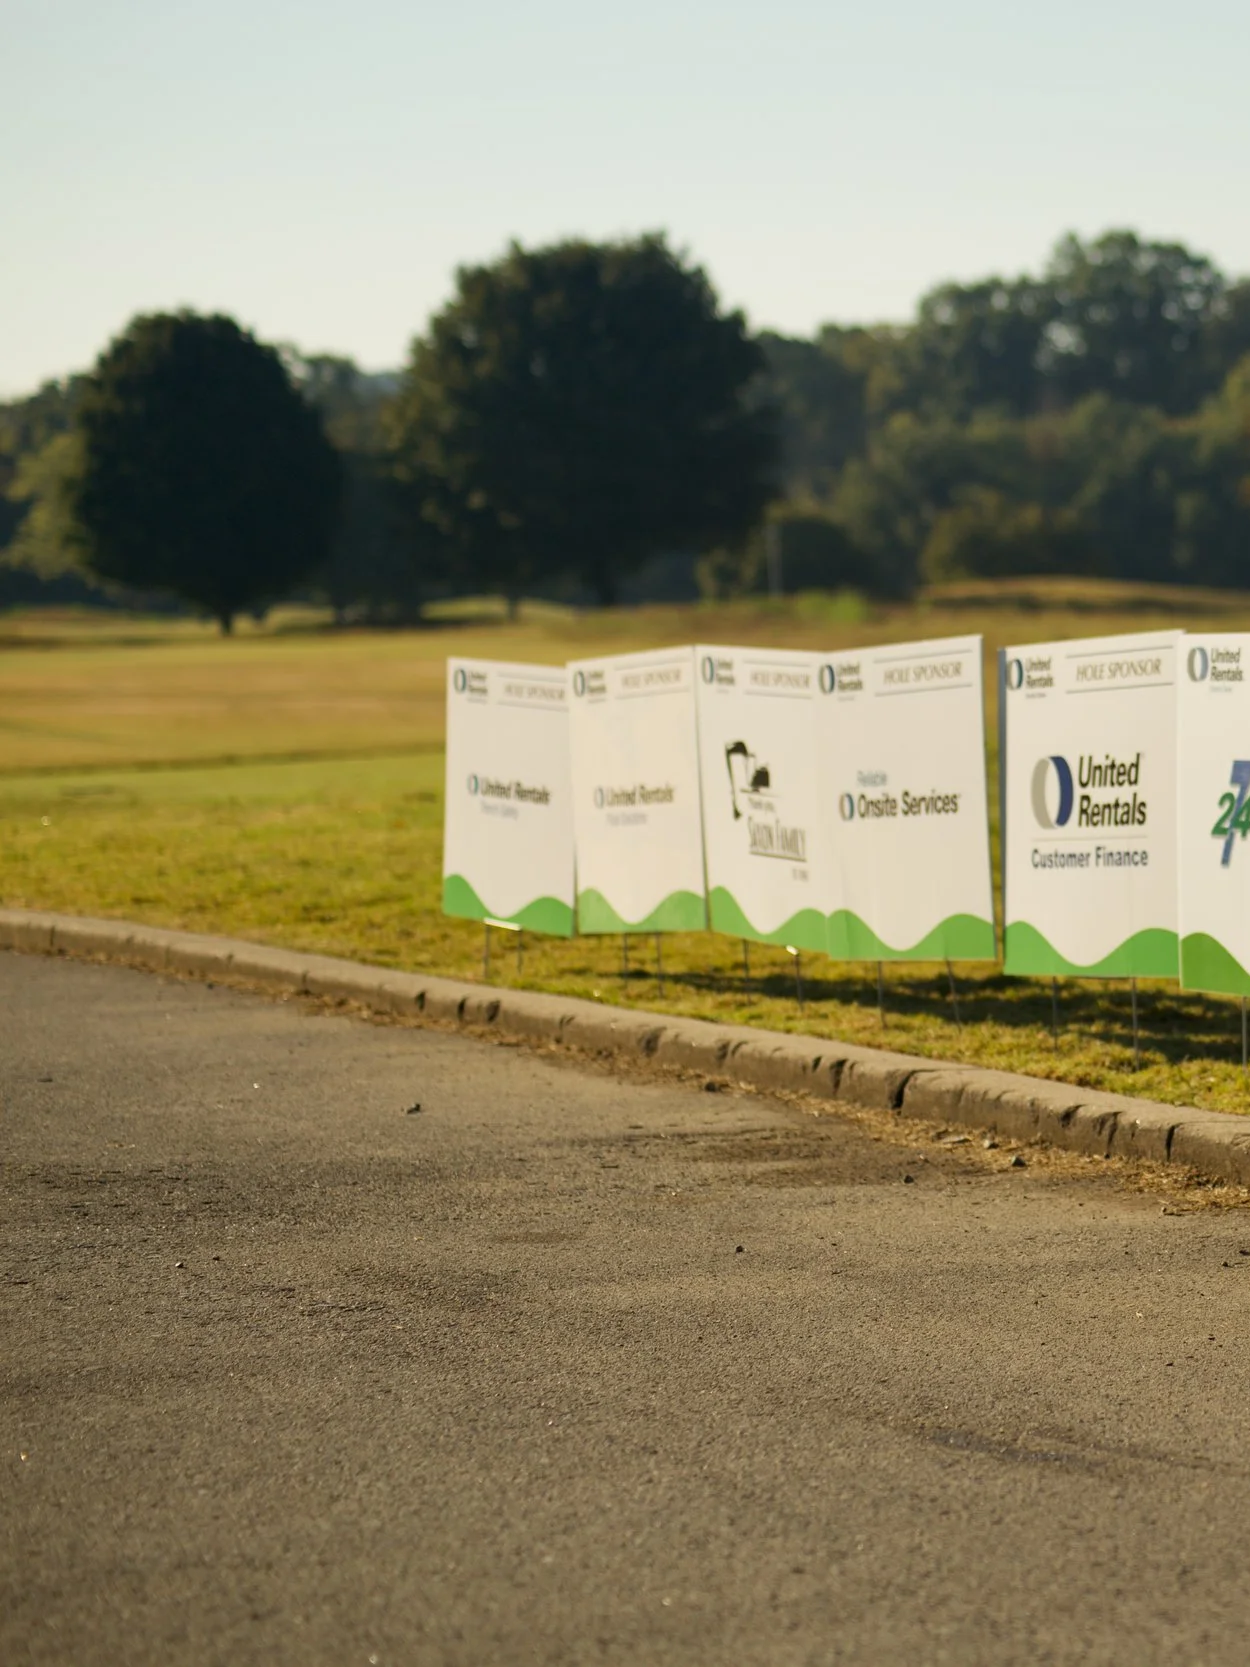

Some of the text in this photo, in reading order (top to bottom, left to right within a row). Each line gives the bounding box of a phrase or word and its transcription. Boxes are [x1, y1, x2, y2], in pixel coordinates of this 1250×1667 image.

[1025, 656, 1051, 673] United
[1210, 647, 1241, 665] United
[884, 661, 962, 686] HOLE SPONSOR
[1025, 674, 1053, 688] Rentals
[1076, 658, 1161, 682] HOLE SPONSOR
[1210, 666, 1243, 682] Rentals
[1078, 752, 1141, 788] United
[480, 777, 550, 805] United Rentals
[605, 781, 674, 806] United Rentals
[857, 787, 958, 818] Onsite Services
[1078, 792, 1147, 828] Rentals
[1031, 845, 1148, 869] Customer Finance
